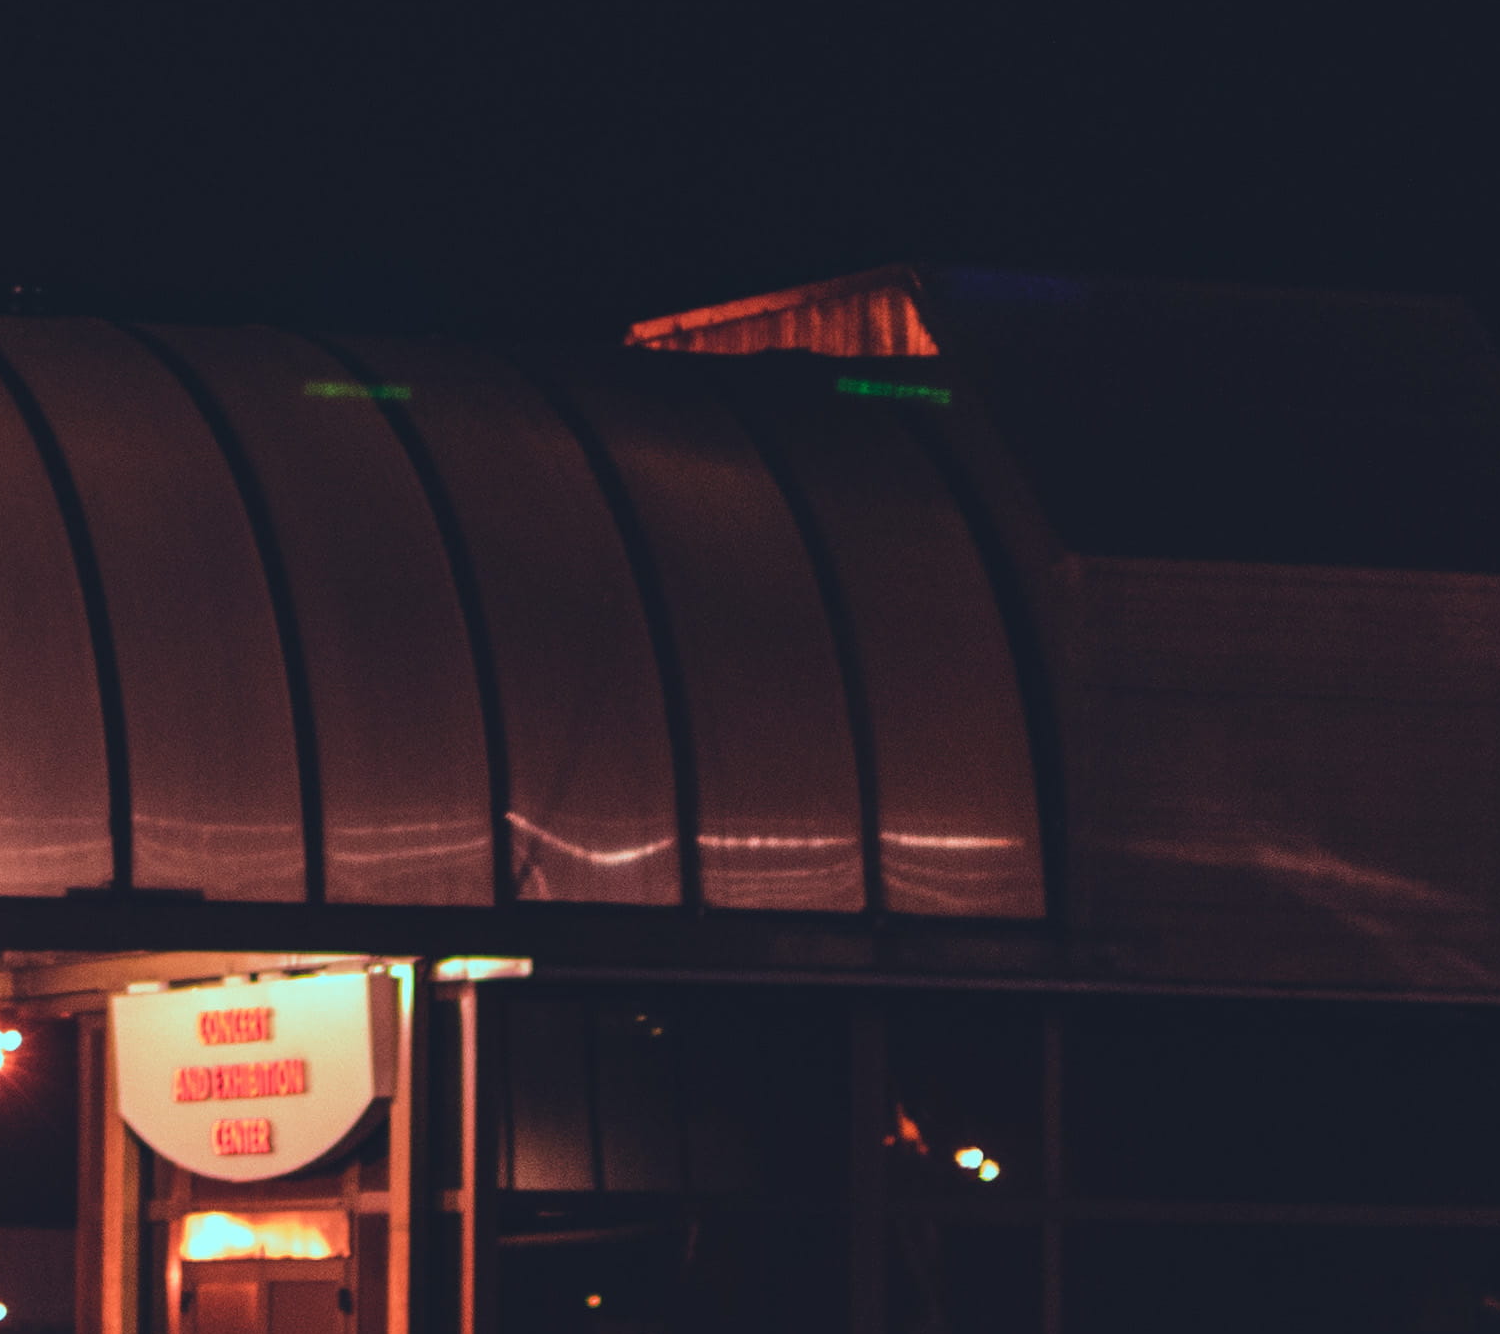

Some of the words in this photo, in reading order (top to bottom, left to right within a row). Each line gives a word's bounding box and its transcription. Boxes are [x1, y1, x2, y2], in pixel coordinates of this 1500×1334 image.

[197, 1007, 273, 1045] CONCERT
[173, 1065, 211, 1102] AND
[212, 1059, 307, 1100] EXHIBITION
[211, 1117, 272, 1155] CENTER
